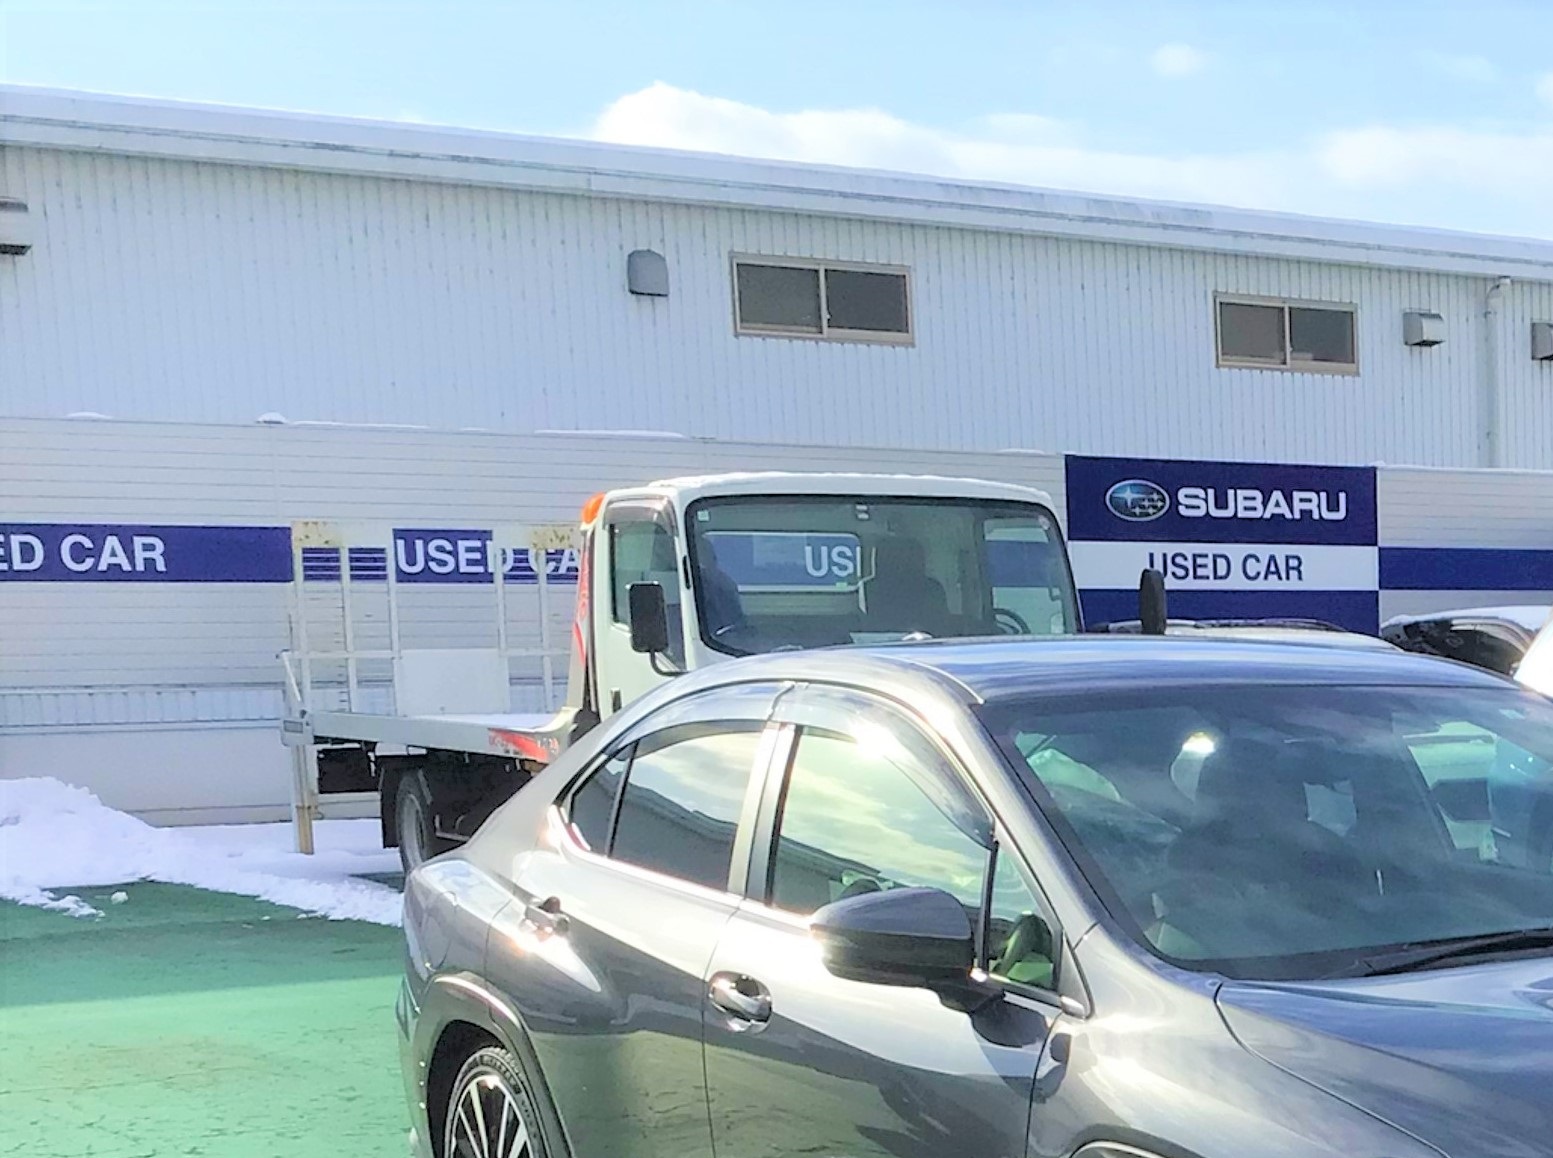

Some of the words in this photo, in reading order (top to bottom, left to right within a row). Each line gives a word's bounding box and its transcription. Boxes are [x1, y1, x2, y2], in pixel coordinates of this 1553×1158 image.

[1177, 487, 1347, 521] SUBARU
[60, 534, 167, 572] CAR
[1148, 552, 1231, 581] USED
[1242, 553, 1303, 582] CAR
